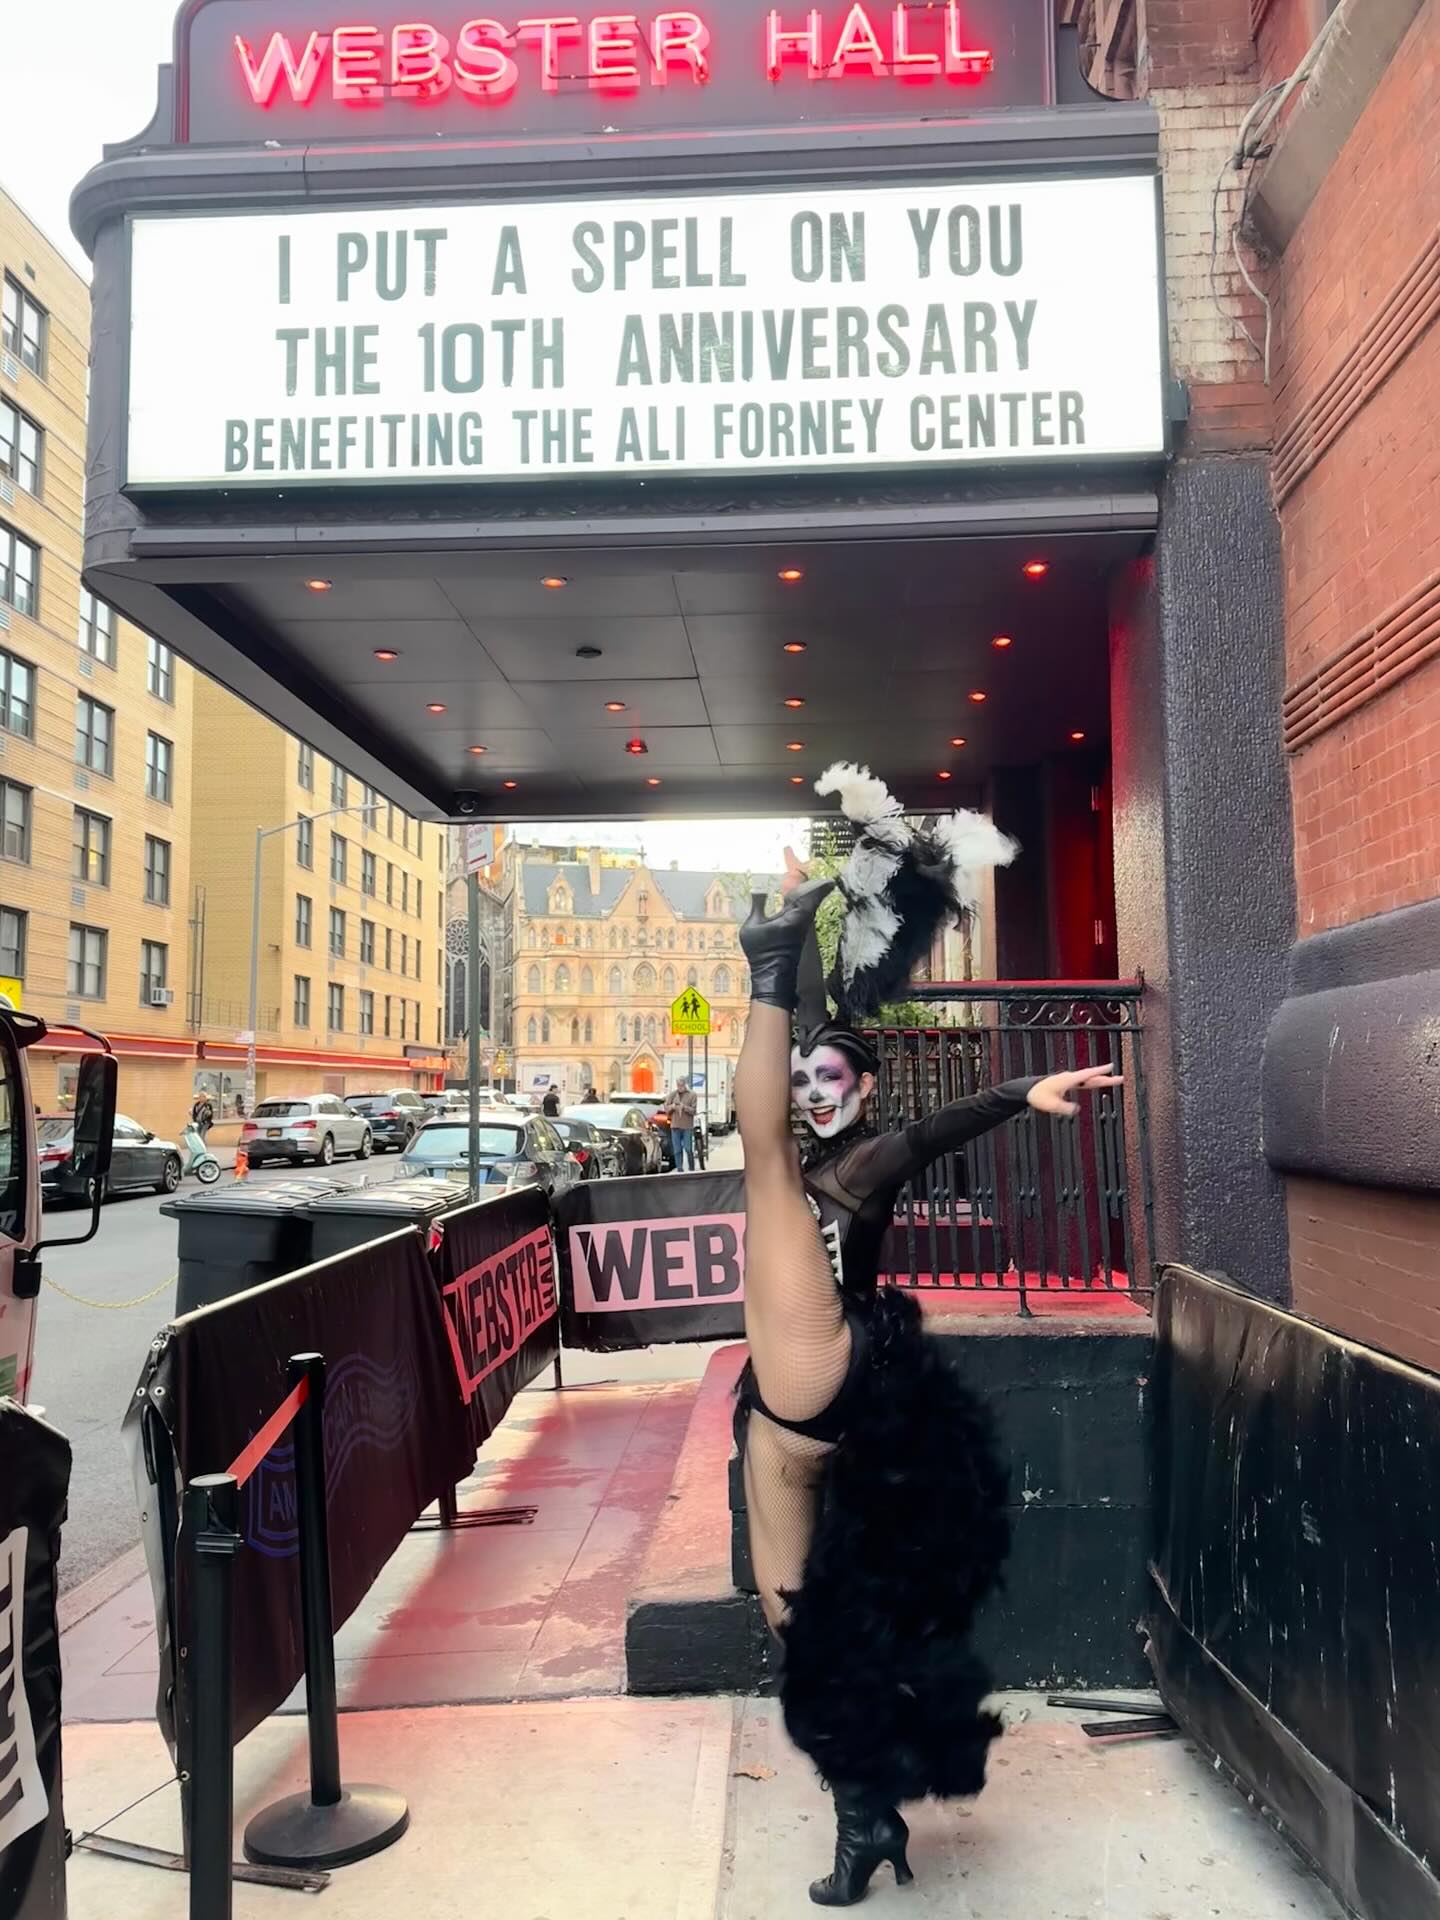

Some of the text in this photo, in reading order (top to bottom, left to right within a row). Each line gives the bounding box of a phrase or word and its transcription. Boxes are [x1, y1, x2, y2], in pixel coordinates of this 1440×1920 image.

[234, 1, 993, 103] WEBSTER HALL
[279, 204, 1022, 304] I PUT A SPELL ON YOU
[276, 300, 1037, 396] THE 10TH ANNIVERSARY
[225, 391, 1085, 471] BENEFITING THE ALI FORNEY CENTER
[674, 1022, 708, 1032] SCHOOL
[443, 1230, 555, 1380] WEBSTER HALL
[576, 1223, 747, 1302] WEB
